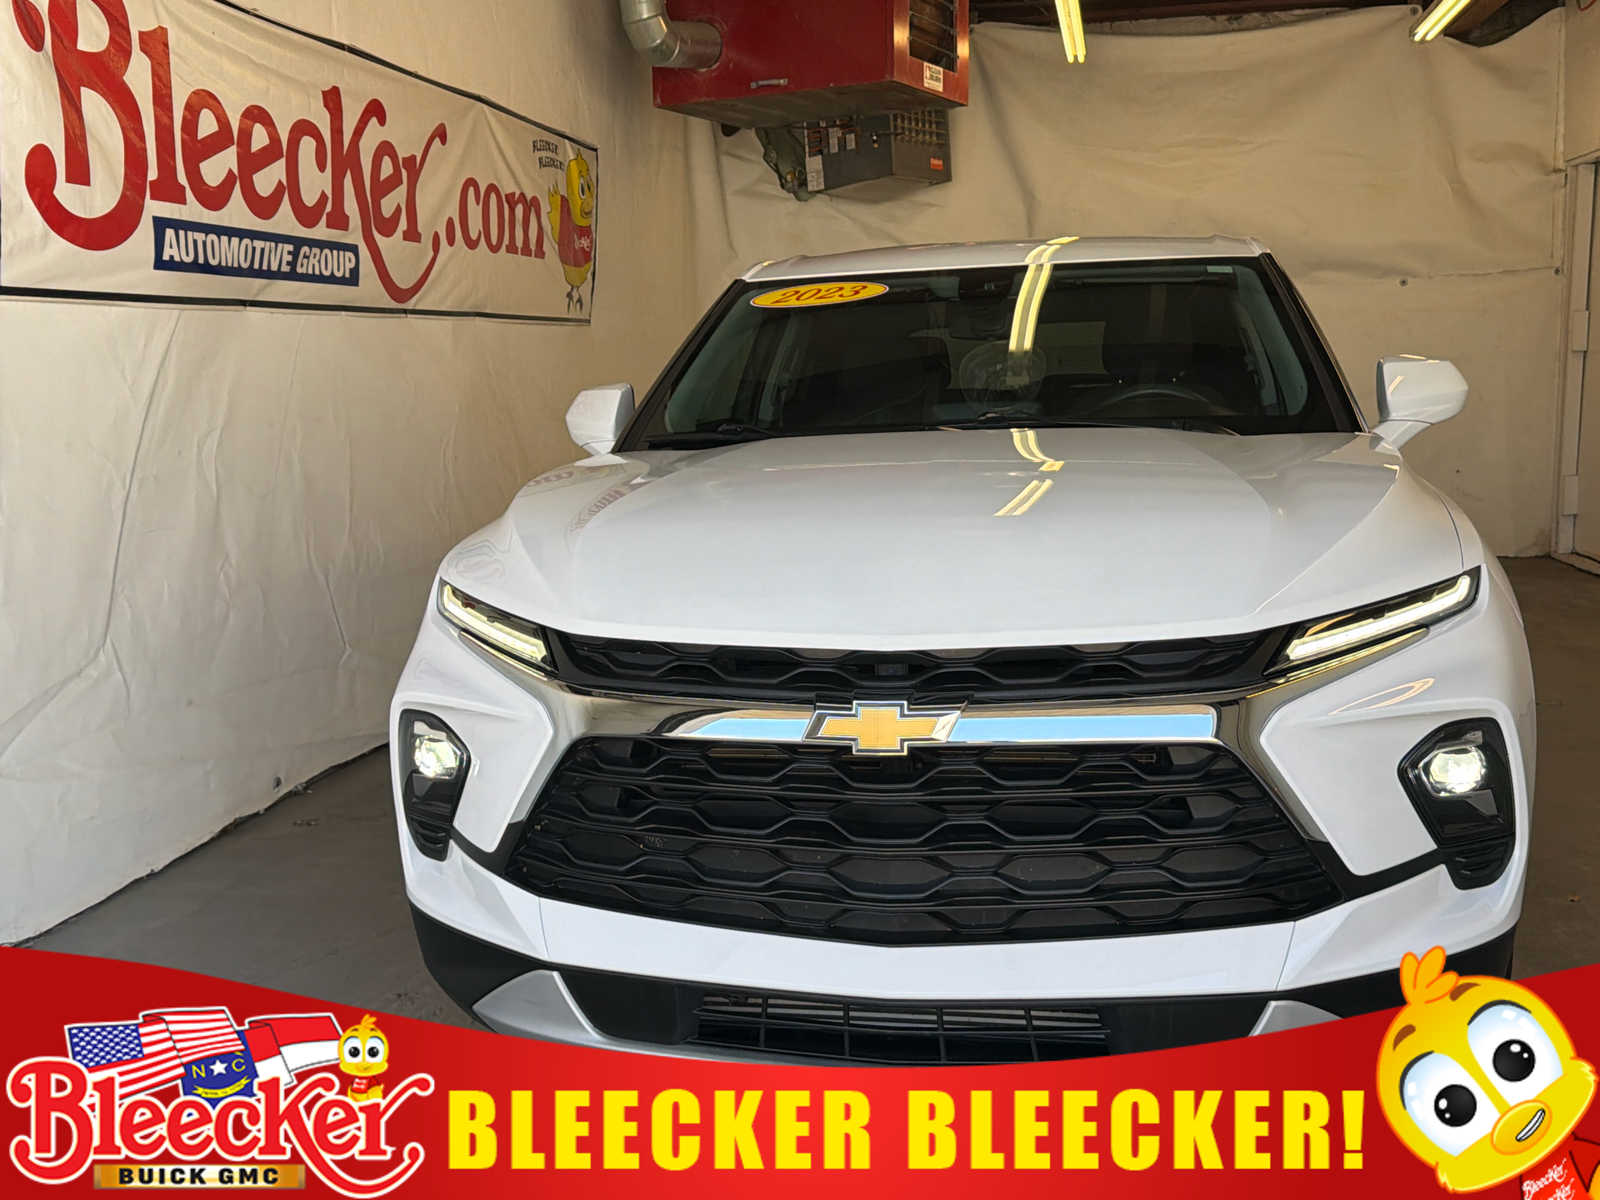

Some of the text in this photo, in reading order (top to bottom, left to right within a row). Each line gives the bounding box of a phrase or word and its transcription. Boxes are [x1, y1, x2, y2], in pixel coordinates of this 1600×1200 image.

[162, 228, 356, 278] AUTOMOTIVE GROUP
[770, 285, 868, 304] 2023
